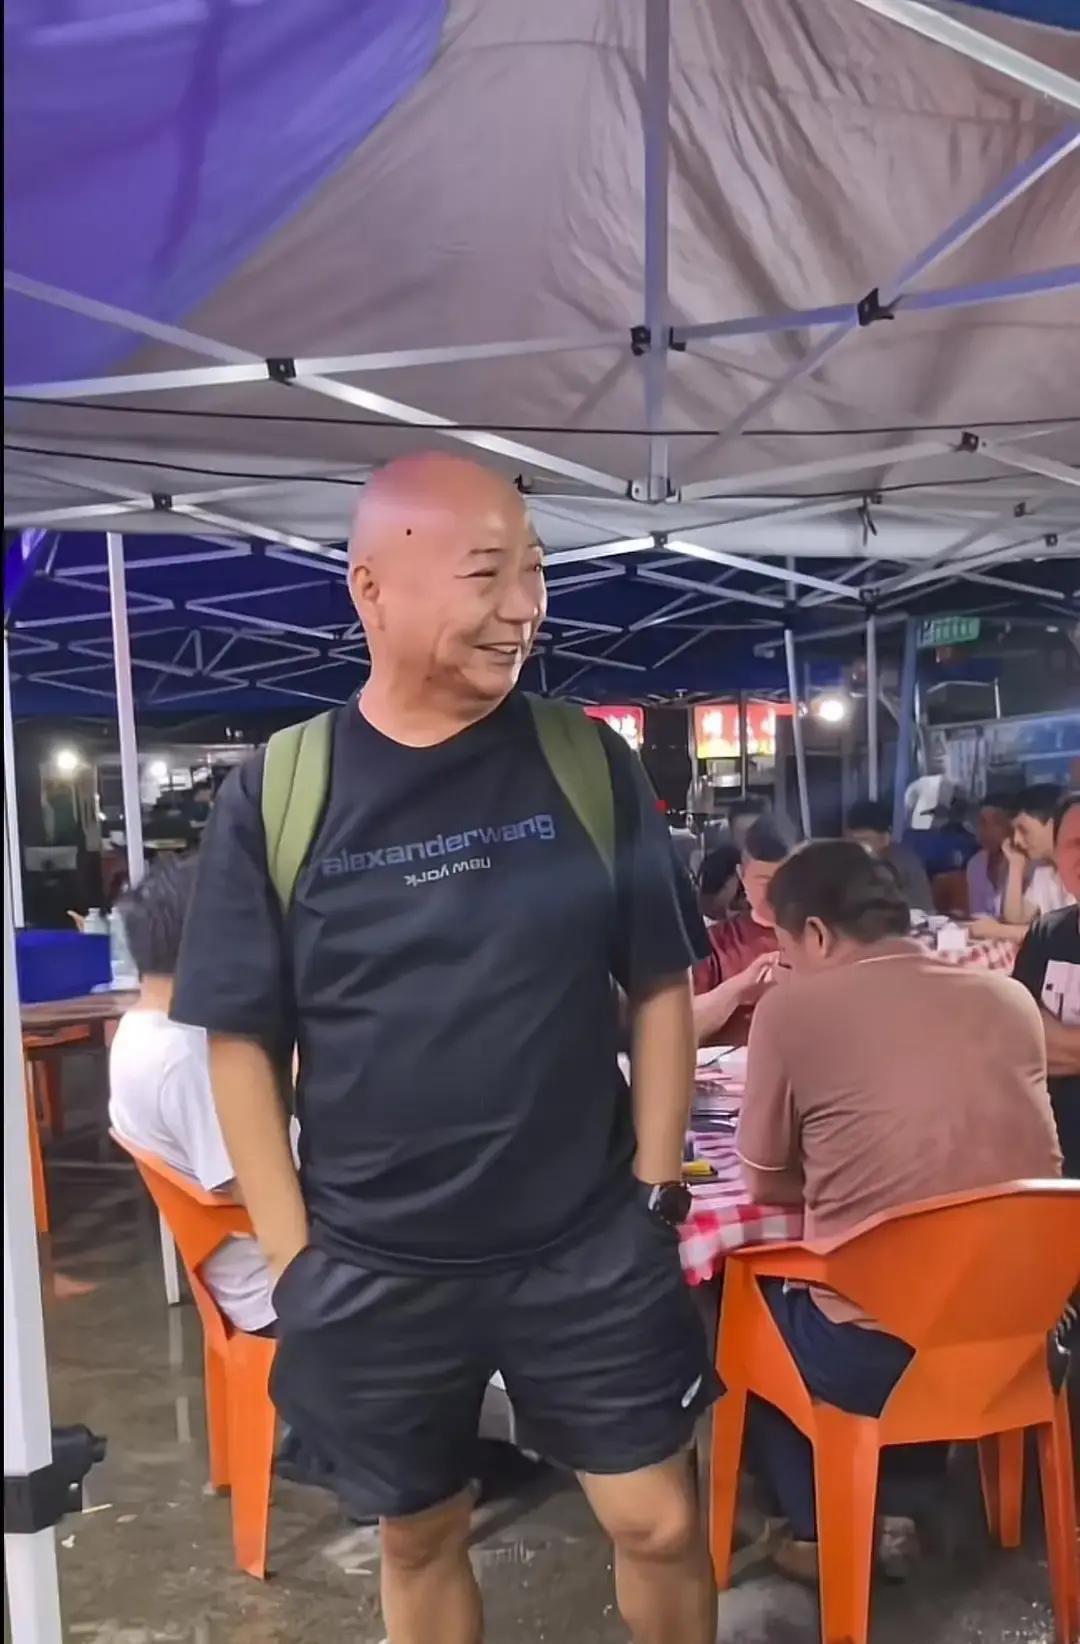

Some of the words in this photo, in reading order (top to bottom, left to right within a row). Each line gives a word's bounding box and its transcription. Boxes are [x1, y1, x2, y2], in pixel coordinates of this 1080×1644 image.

[321, 814, 556, 876] alexanderwang
[403, 862, 450, 887] york
[452, 856, 491, 874] new
